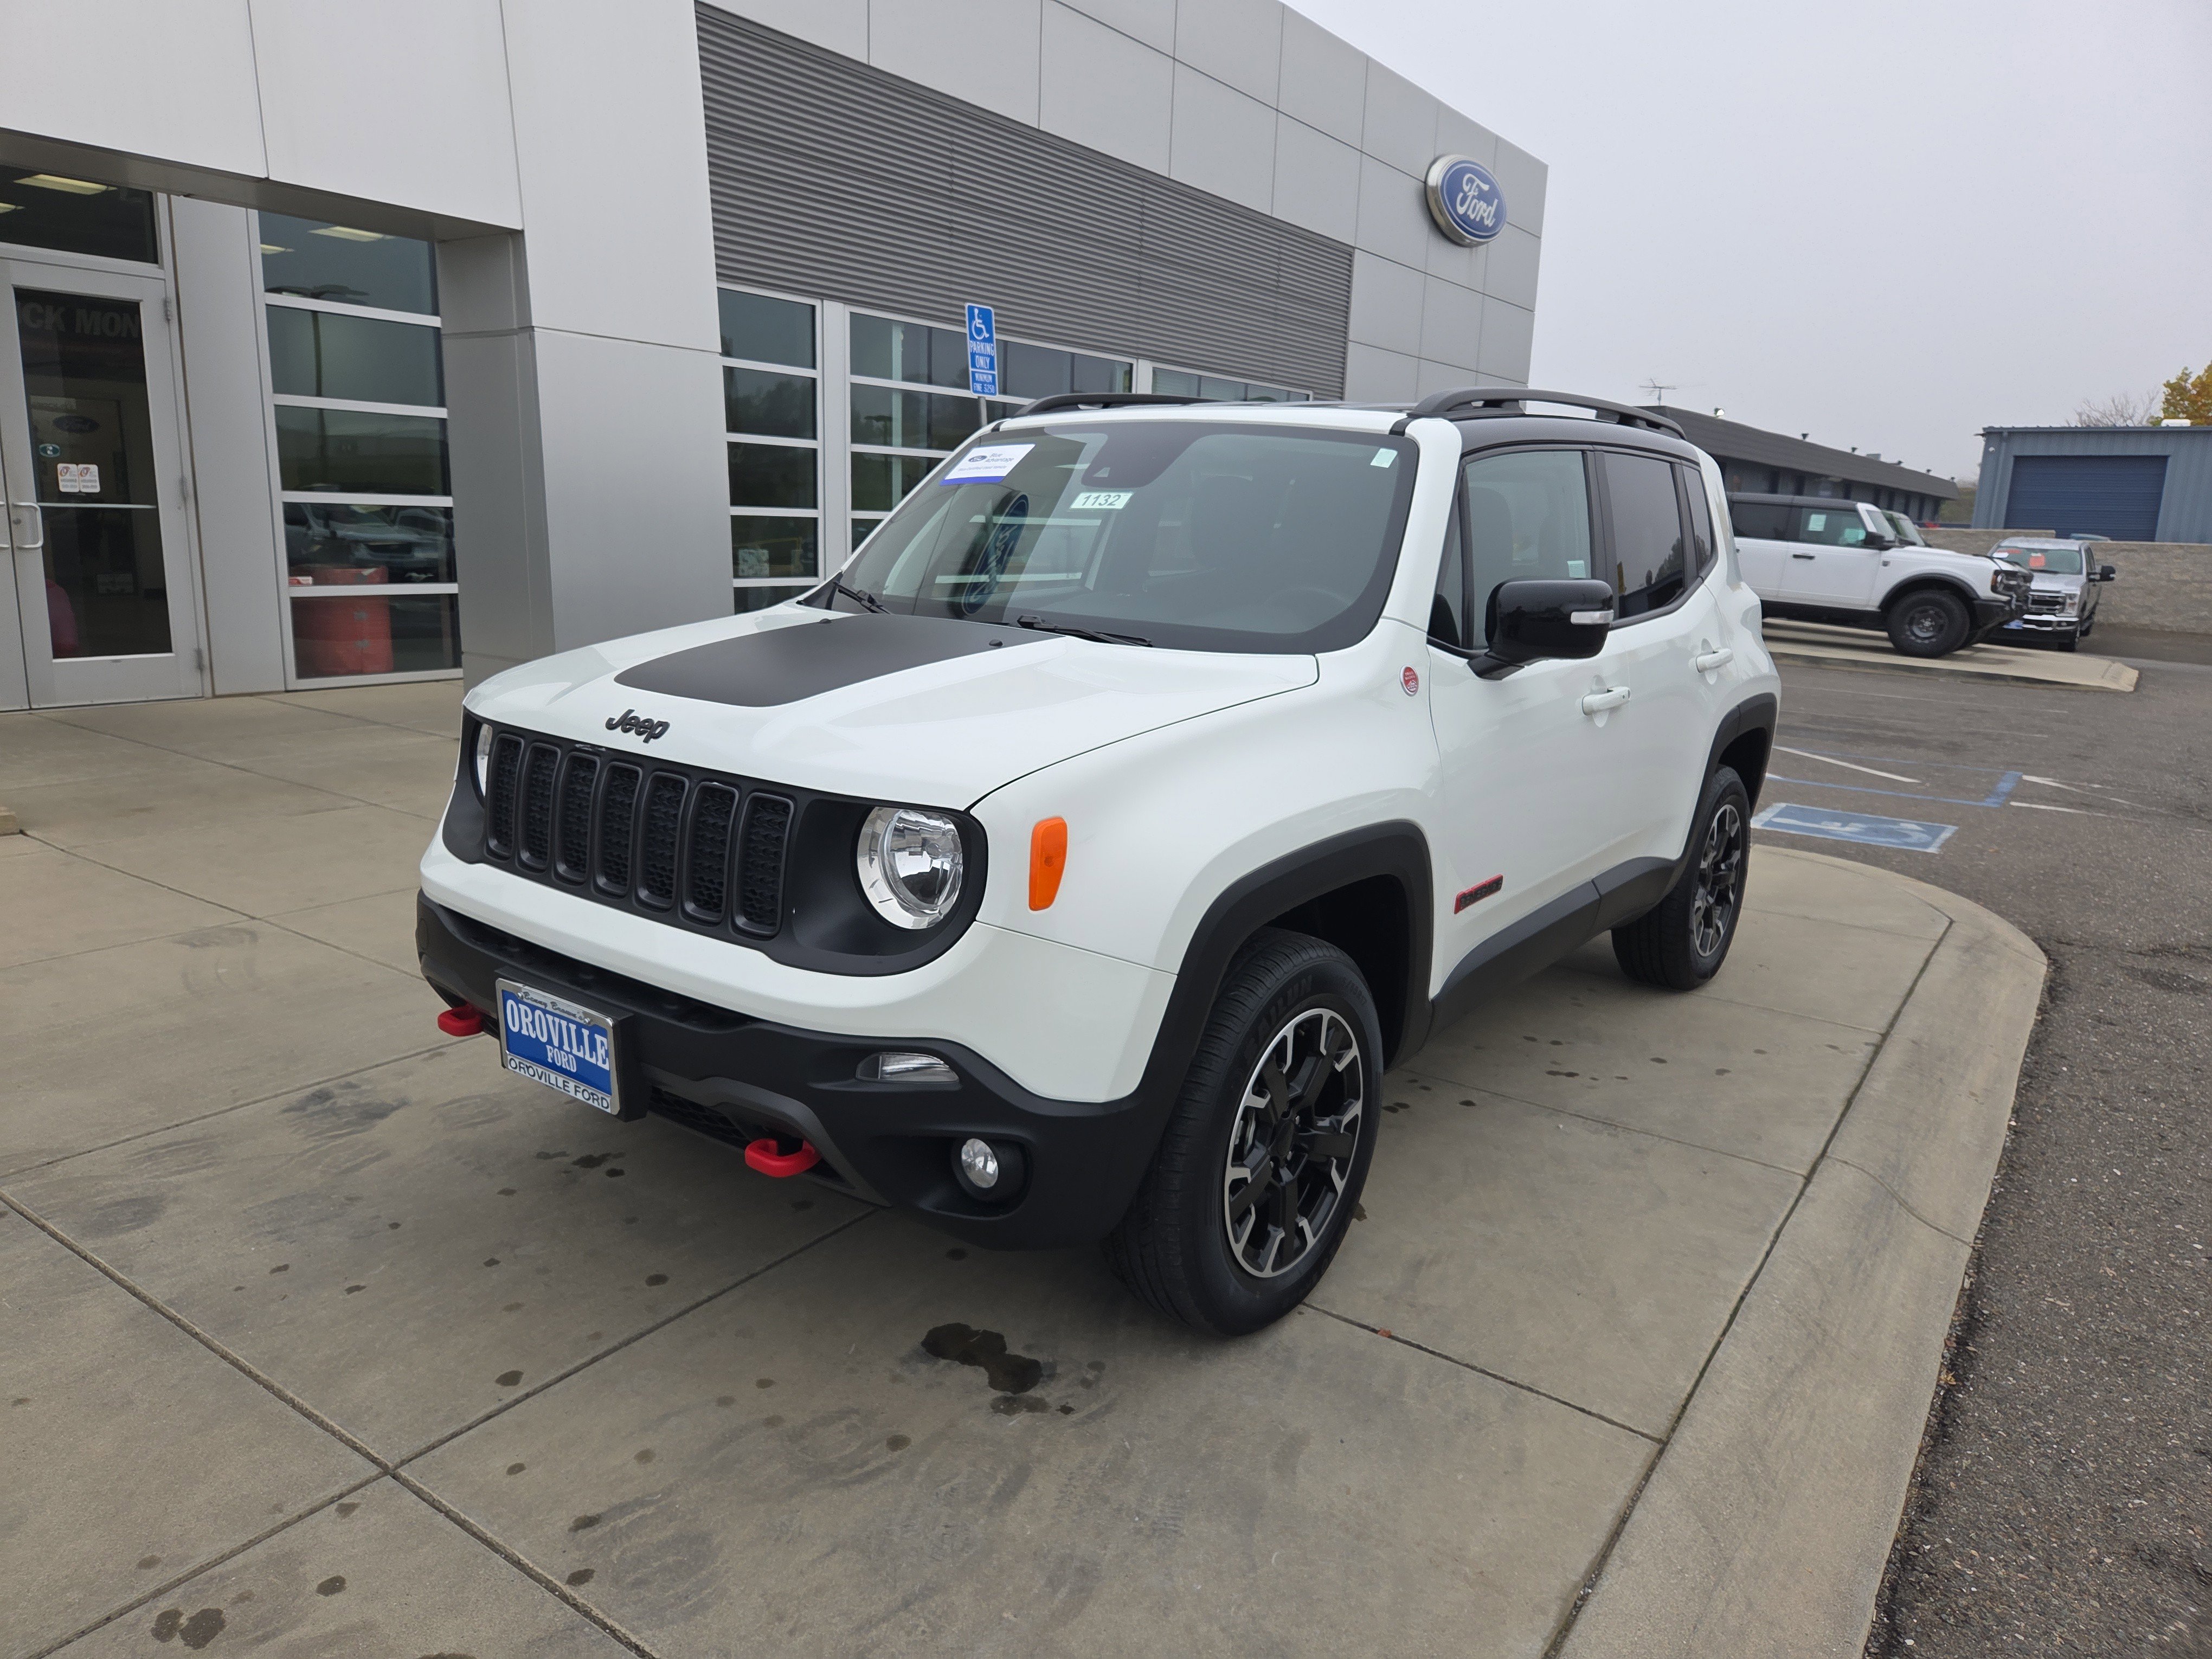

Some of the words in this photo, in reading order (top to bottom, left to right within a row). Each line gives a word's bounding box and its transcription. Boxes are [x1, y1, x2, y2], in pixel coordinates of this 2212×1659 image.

[1456, 173, 1498, 227] Ford
[970, 340, 994, 356] PARKING
[976, 355, 990, 369] ONLY
[974, 382, 982, 392] FINE
[984, 383, 995, 394] $250
[1082, 494, 1121, 506] 1132
[606, 709, 670, 743] Jeep
[506, 999, 609, 1071] OROVILLE
[546, 1045, 576, 1072] FORD
[509, 1057, 570, 1093] OROVILLE
[574, 1085, 609, 1110] FORD
